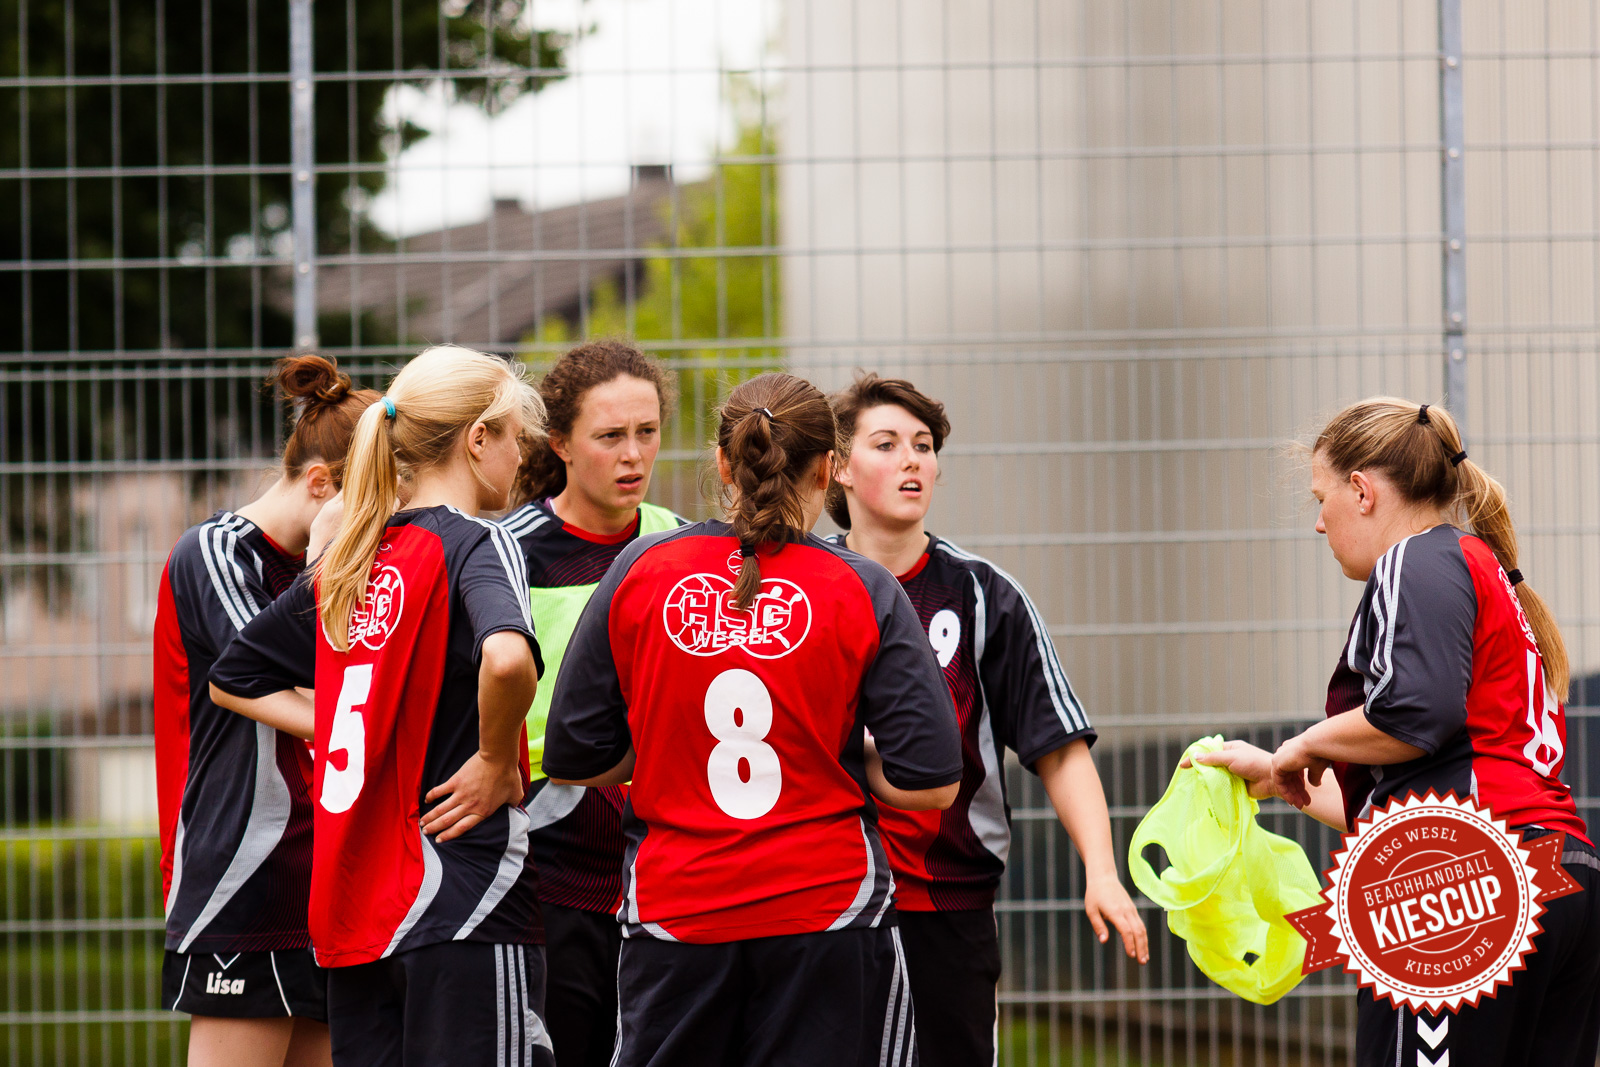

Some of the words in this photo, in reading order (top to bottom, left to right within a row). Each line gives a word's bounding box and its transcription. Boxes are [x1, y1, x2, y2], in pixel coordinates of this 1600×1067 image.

[348, 618, 382, 643] ESEL
[682, 589, 792, 633] HSG
[691, 627, 773, 648] WESEL
[929, 609, 961, 668] 9
[319, 663, 374, 814] 5
[704, 668, 782, 820] 8
[206, 972, 245, 996] Lisa
